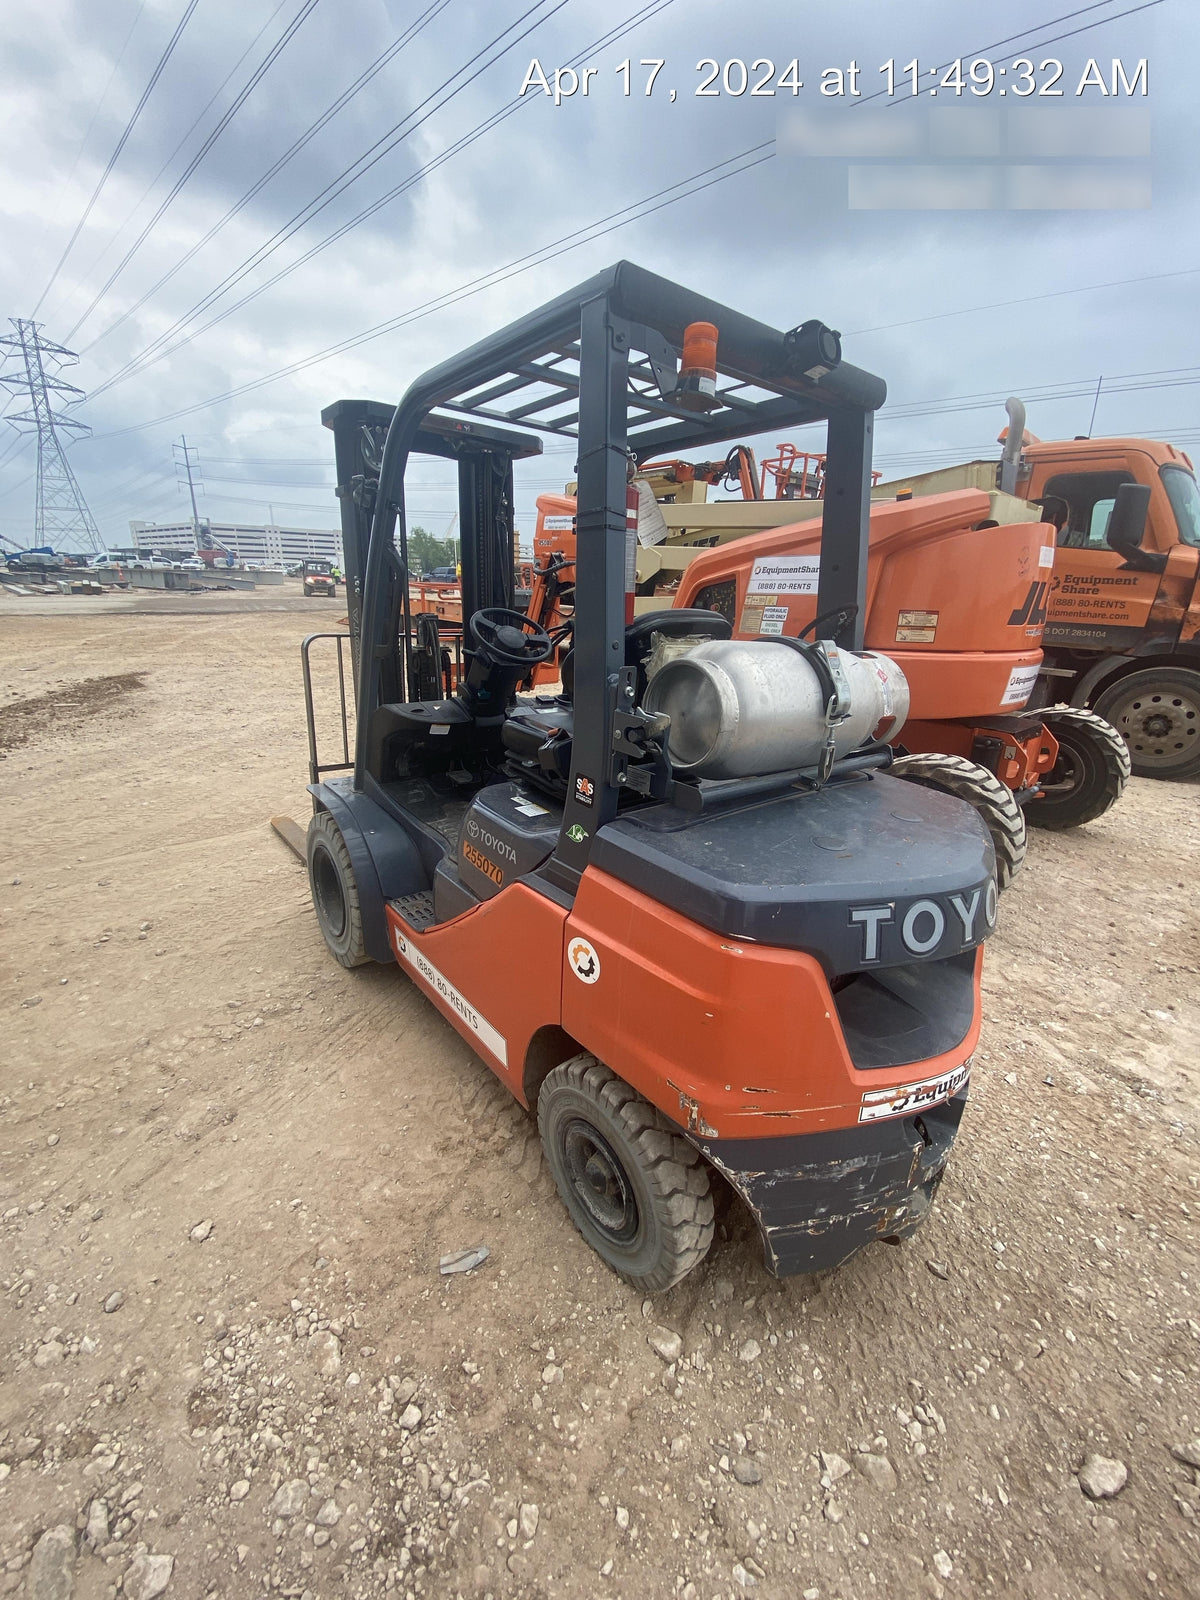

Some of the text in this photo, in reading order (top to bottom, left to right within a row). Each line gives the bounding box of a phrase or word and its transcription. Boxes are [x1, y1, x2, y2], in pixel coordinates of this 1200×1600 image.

[1064, 574, 1139, 586] Equipment
[1061, 584, 1100, 595] Share
[1053, 598, 1126, 609] (888) 80-RENTS
[1071, 629, 1107, 638] 2834104
[576, 777, 594, 796] SAS
[480, 829, 517, 864] TOYOTA
[465, 843, 503, 886] 255070
[416, 956, 479, 1030] (888) 80-RENTS
